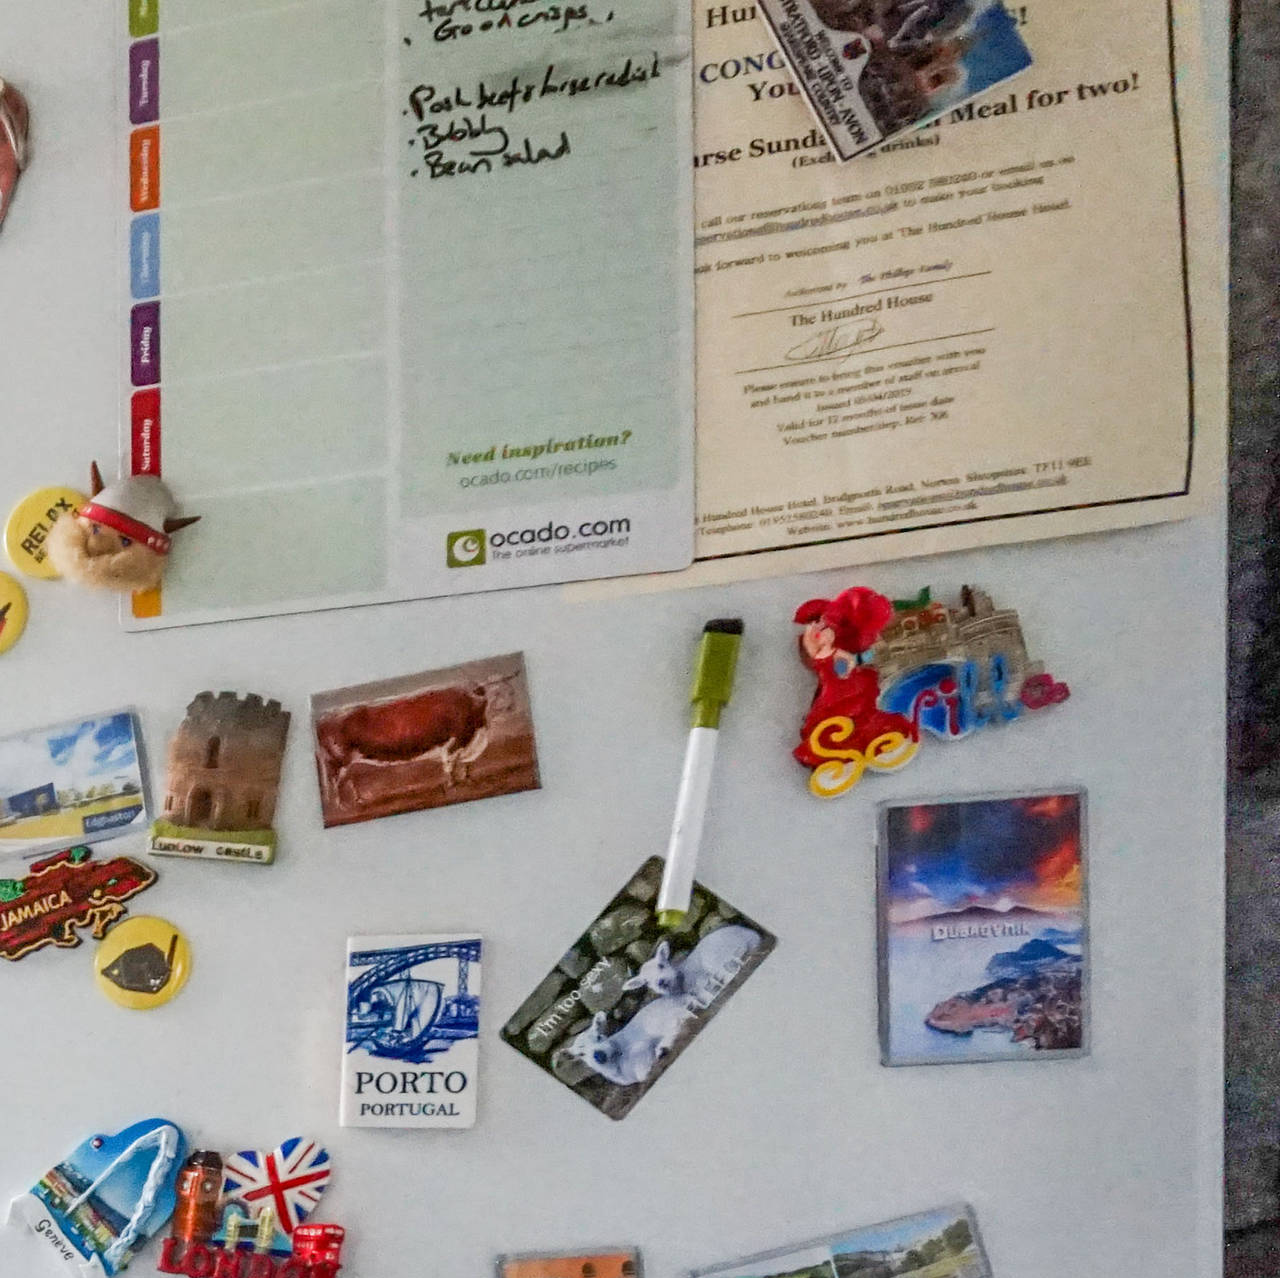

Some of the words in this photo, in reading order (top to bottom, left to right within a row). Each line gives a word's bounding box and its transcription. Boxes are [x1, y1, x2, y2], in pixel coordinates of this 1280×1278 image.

[950, 94, 1019, 124] Meal
[1026, 89, 1070, 110] for
[1077, 72, 1140, 101] two!
[839, 108, 868, 145] AVON
[790, 314, 817, 327] The
[820, 299, 883, 322] Hundred
[886, 292, 935, 309] House
[140, 325, 153, 365] Friday
[140, 417, 153, 472] Saturday
[446, 444, 497, 467] Need
[501, 428, 633, 460] inspiration?
[489, 517, 632, 549] ocado.com
[0, 890, 73, 932] JAMAICA
[535, 1007, 563, 1038] I'm
[559, 988, 583, 1018] too
[579, 954, 613, 989] sexy
[354, 1070, 468, 1095] PORTO
[359, 1102, 460, 1117] PORTUGAL
